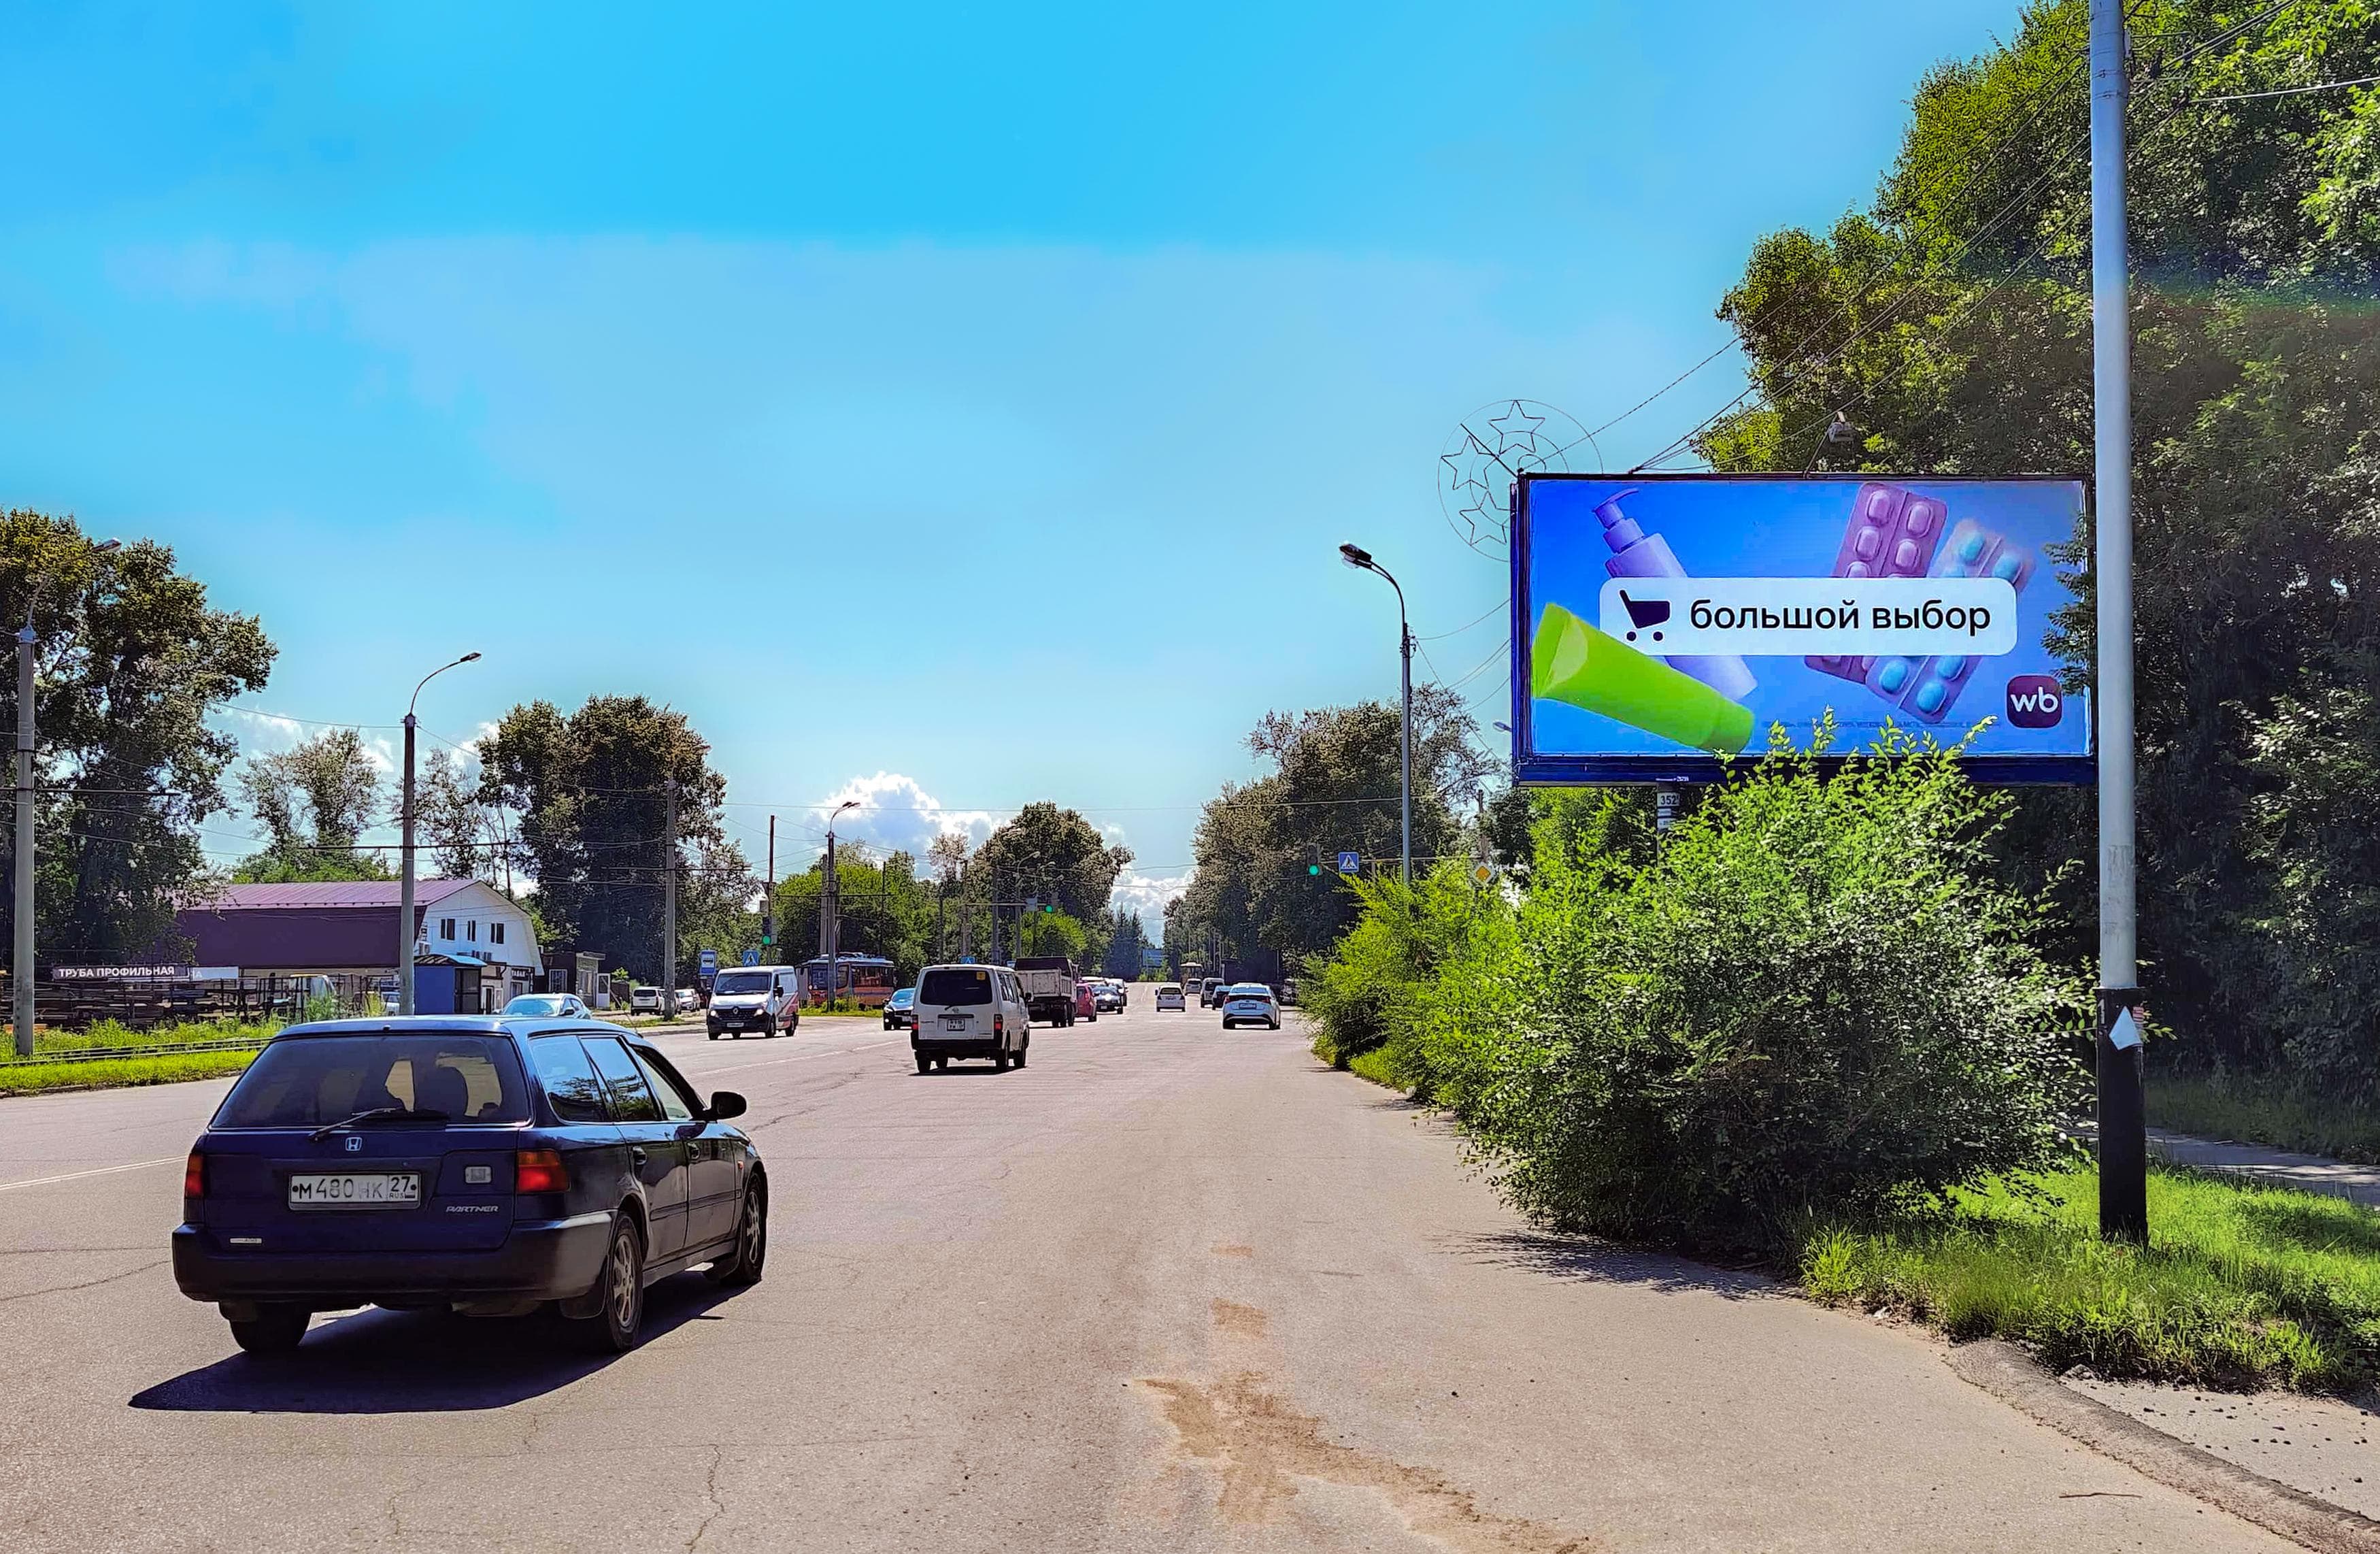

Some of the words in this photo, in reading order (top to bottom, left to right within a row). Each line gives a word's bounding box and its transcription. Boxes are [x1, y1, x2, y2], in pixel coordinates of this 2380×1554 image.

[1690, 599, 1859, 629] большой
[1873, 599, 1990, 636] выбор
[2010, 687, 2058, 713] wb
[58, 968, 95, 978] ТРУБА
[97, 966, 175, 977] ПРОФИЛЬНАЯ
[391, 1176, 411, 1192] 27
[446, 1205, 499, 1213] PARTNER
